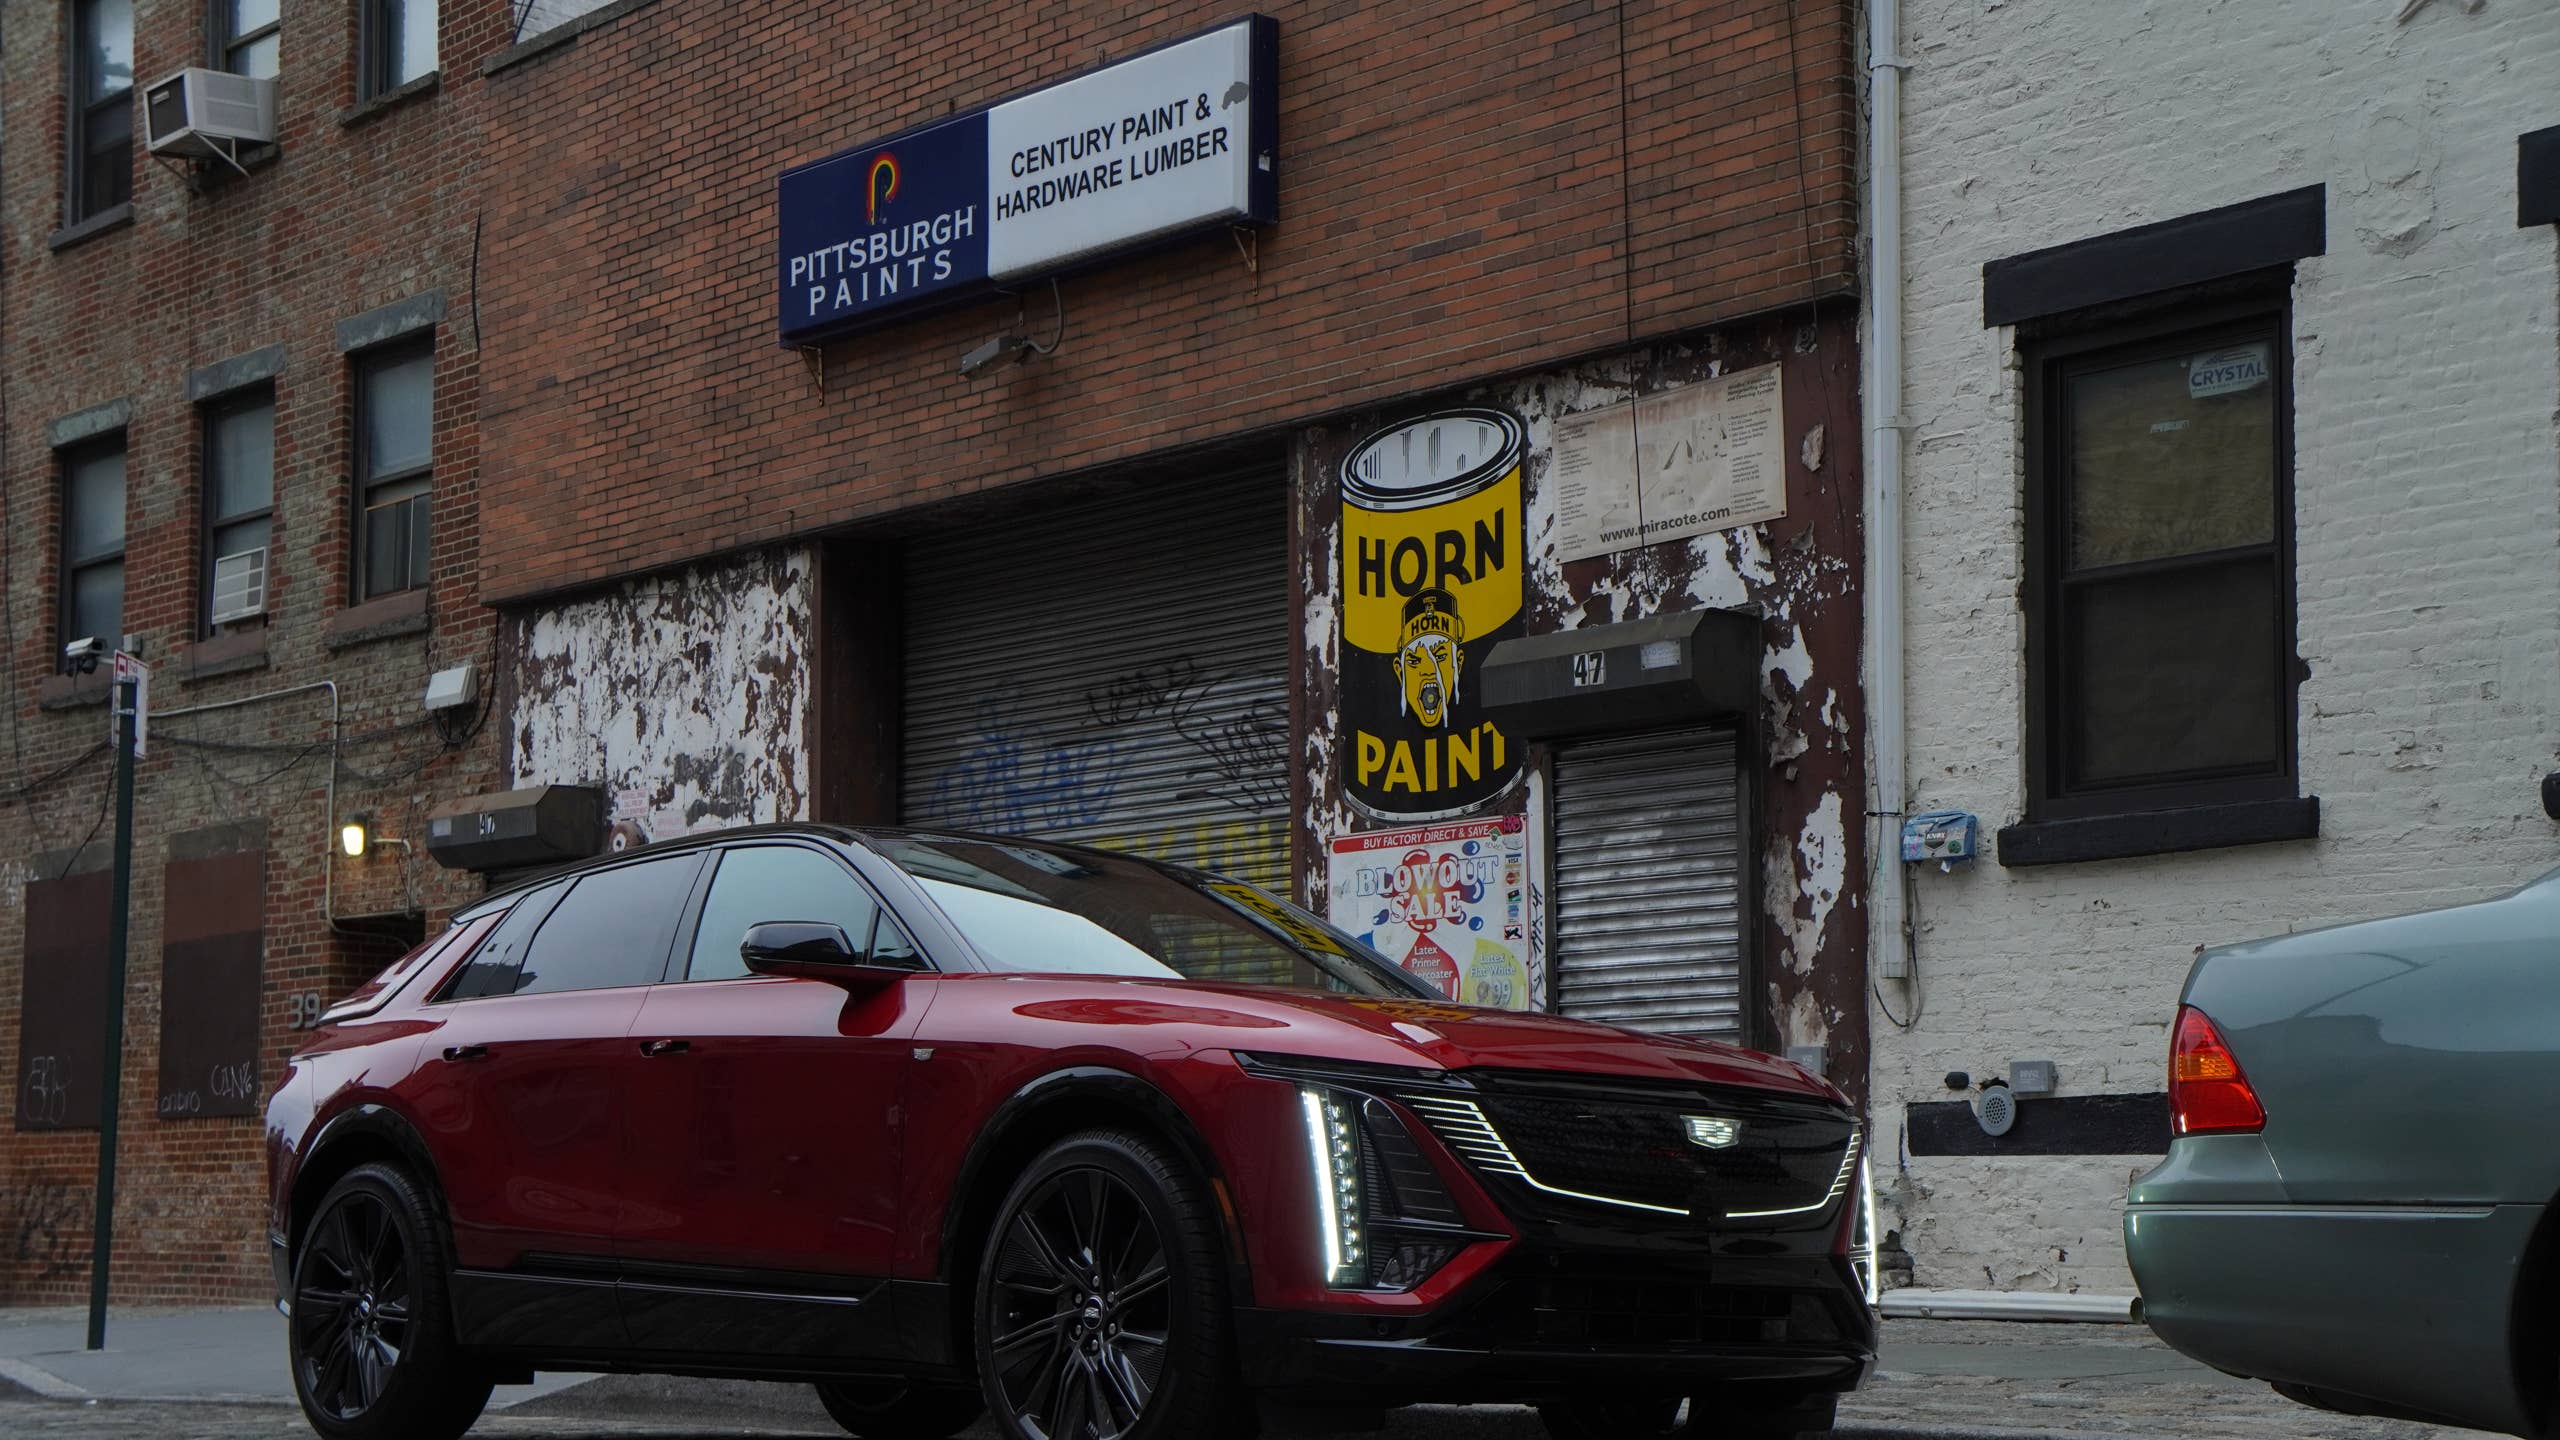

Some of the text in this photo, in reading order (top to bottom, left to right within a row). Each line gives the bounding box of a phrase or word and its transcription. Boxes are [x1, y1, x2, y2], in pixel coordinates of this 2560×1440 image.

[1011, 92, 1212, 178] CENTURY PAINT &
[996, 127, 1229, 221] HARDWARE LUMBER
[790, 204, 976, 288] PITTSBURGH
[809, 249, 952, 316] PAINTS
[2191, 360, 2266, 388] CRYSTAL
[1599, 506, 1731, 543] www.miracote.com
[1358, 507, 1505, 598] HORN
[1410, 615, 1450, 637] HORN
[1574, 653, 1603, 685] 47
[1363, 825, 1489, 849] BUY FACTORY DIRECT & SAVE
[1356, 855, 1499, 897] BLOWOUT
[1390, 889, 1462, 924] SALE
[1411, 957, 1441, 968] Primer
[1414, 945, 1438, 956] Latex
[289, 993, 321, 1029] 39
